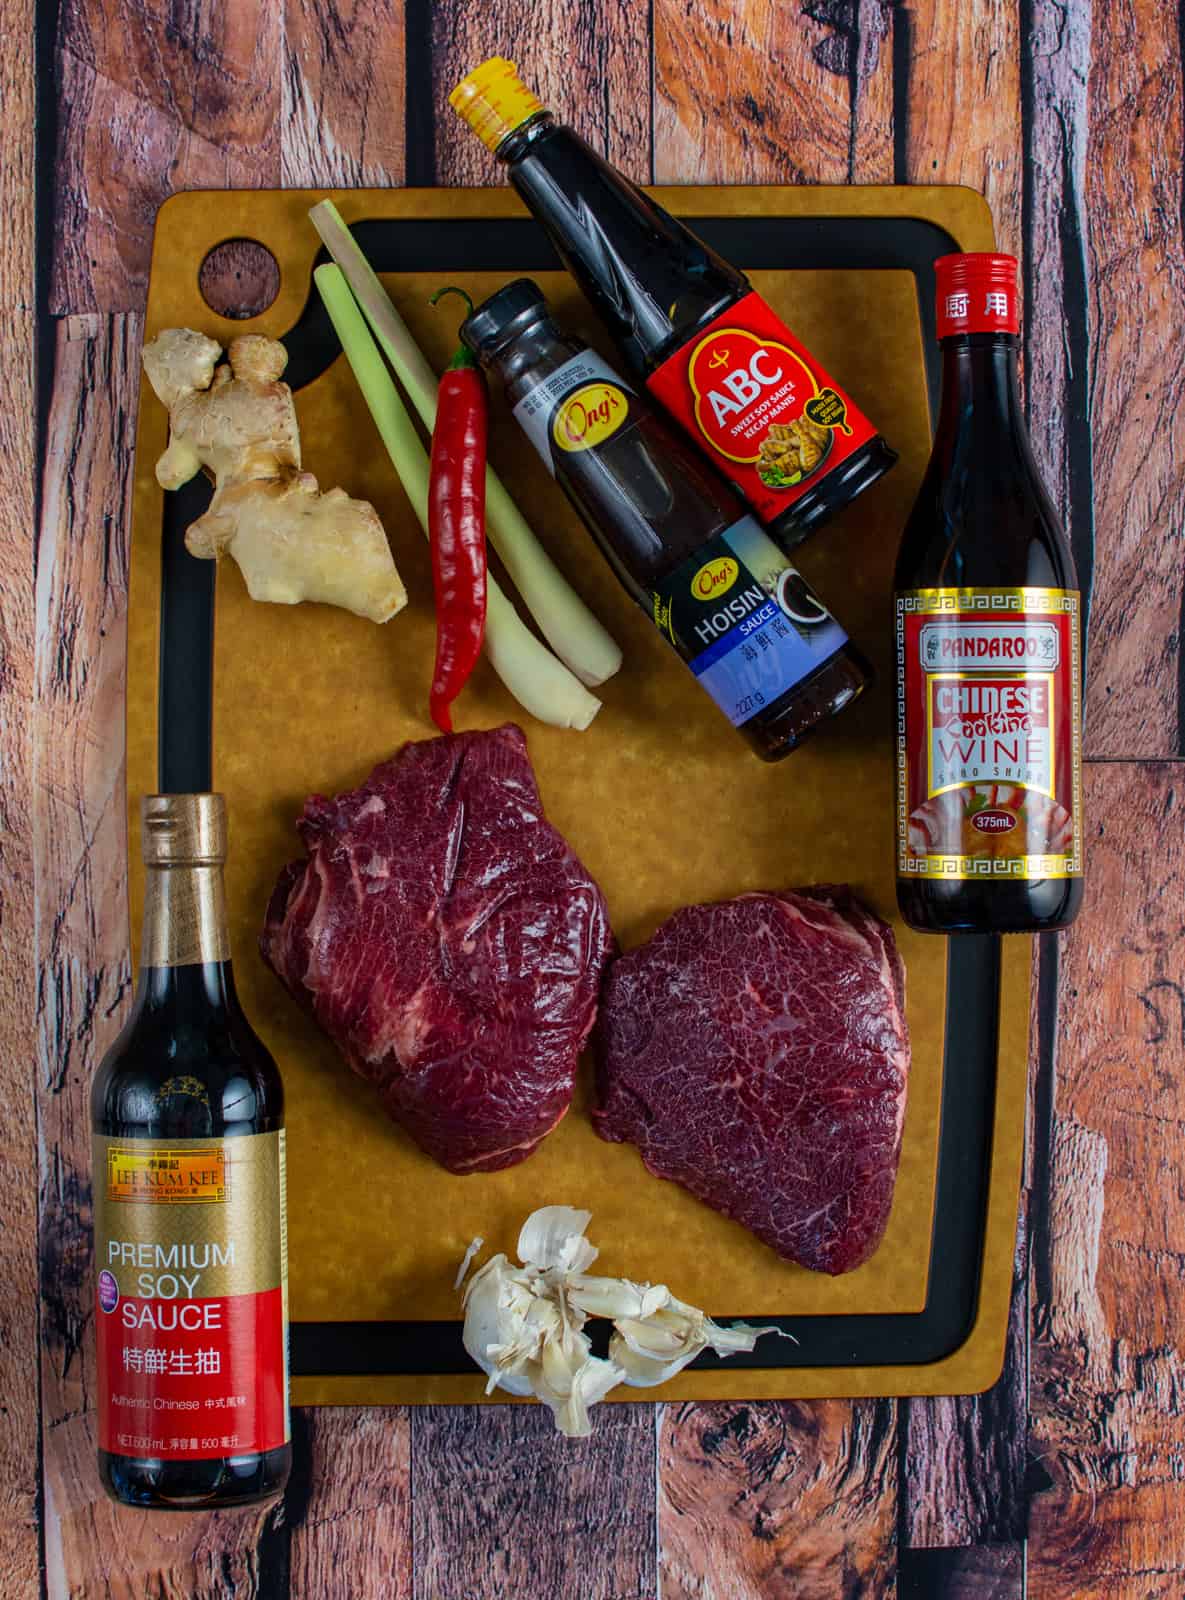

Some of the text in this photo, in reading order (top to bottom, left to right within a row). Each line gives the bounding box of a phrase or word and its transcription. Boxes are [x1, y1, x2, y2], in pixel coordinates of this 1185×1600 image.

[706, 349, 783, 428] ABC
[565, 388, 619, 442] Ong's
[730, 381, 796, 437] SWEET SOY SAUCE
[744, 394, 796, 439] KECAP MANIS
[698, 561, 733, 595] Ong's
[694, 585, 765, 644] HOISIN
[739, 604, 776, 636] SAUCE
[941, 637, 1037, 658] PANDAROO
[937, 687, 1045, 714] CHINESE
[938, 739, 1044, 764] WINE
[976, 815, 1013, 830] 375mL
[117, 1169, 219, 1186] LEE KUM KEE
[108, 1239, 236, 1269] PREMIUM
[138, 1274, 200, 1300] SOY
[122, 1303, 222, 1330] SAUCE
[122, 1346, 221, 1376] 特鮮生抽
[153, 1397, 200, 1410] Chinese
